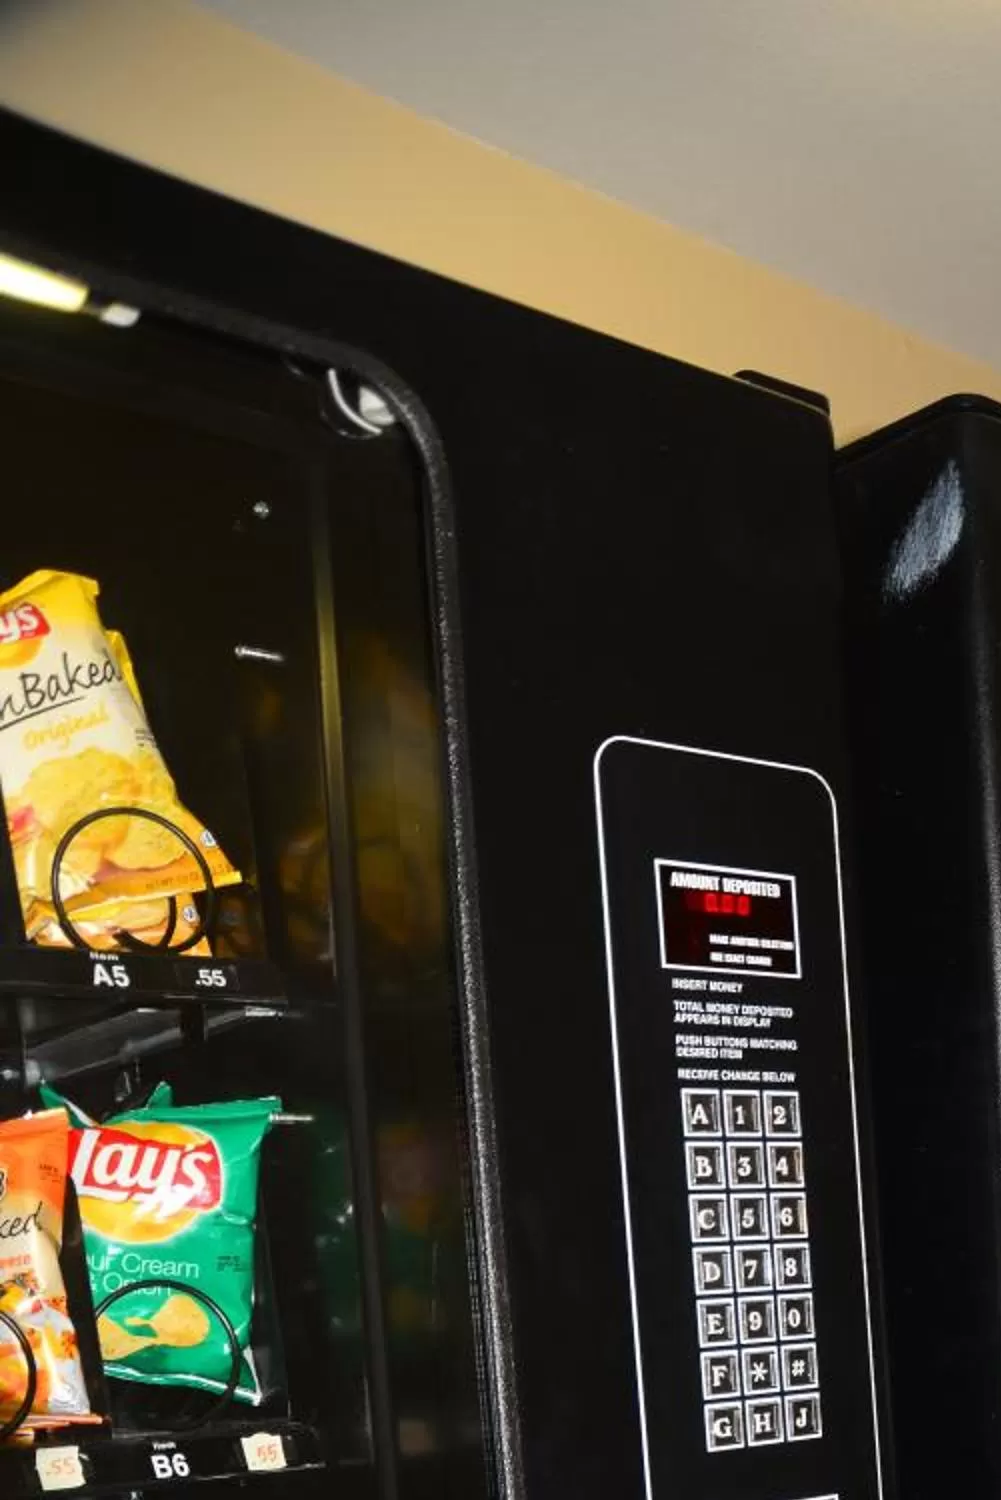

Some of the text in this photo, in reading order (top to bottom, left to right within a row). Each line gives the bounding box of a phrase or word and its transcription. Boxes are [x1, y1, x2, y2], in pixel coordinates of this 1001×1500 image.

[670, 871, 780, 898] AMOUNT DEPOSITED
[93, 963, 131, 987] A5
[195, 969, 227, 987] .55
[671, 977, 743, 993] INSERT MONEY
[673, 999, 794, 1019] TOTAL MONEY DEPOSITED
[673, 1011, 771, 1028] APPEARS IN DISPLAY
[675, 1033, 798, 1051] PUSH BUTTONS MATCHING
[675, 1046, 743, 1059] DESIRED ITEM
[677, 1067, 797, 1084] RECEIVE CHANGE BELOW
[691, 1104, 787, 1126] A 1 2
[72, 1128, 214, 1219] Lay's
[695, 1156, 789, 1177] B 3 4
[699, 1207, 793, 1230] C 5 6
[121, 1252, 200, 1279] Cream
[703, 1257, 798, 1283] D 7 8
[707, 1308, 801, 1335] E 9 0
[711, 1365, 728, 1387] F
[713, 1407, 808, 1438] G H J
[151, 1453, 190, 1479] B6
